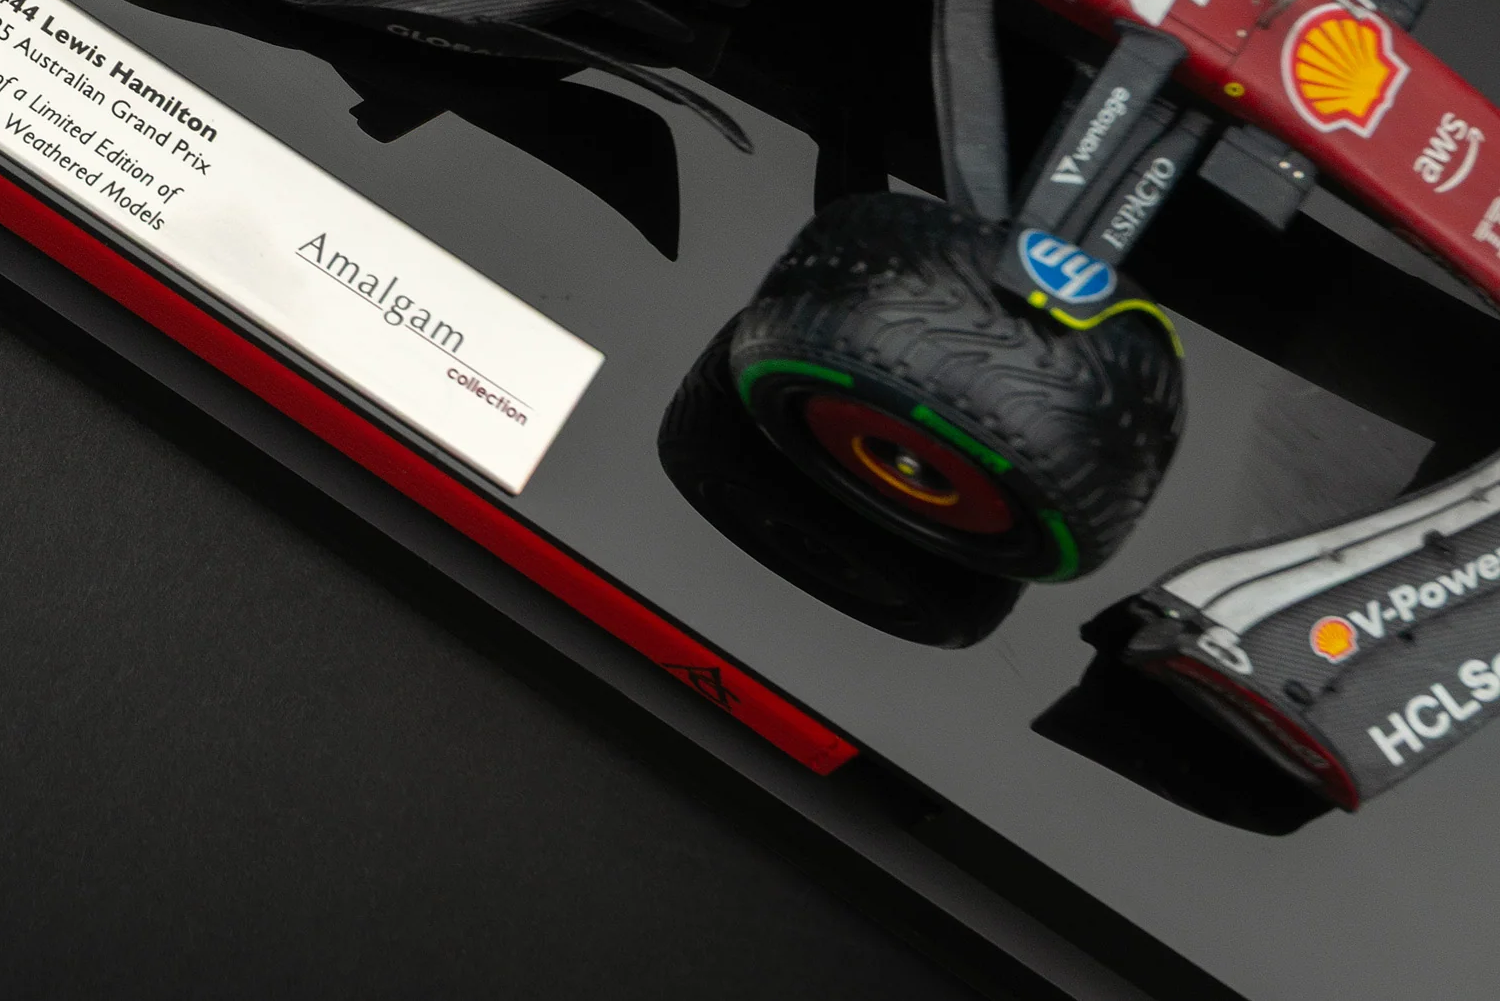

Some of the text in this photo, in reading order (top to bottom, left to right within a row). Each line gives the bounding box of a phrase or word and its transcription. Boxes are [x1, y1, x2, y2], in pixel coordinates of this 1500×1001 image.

[13, 37, 107, 106] Australian
[110, 99, 173, 148] Grand
[171, 138, 212, 176] Prix
[40, 15, 107, 68] Lewis
[109, 61, 219, 142] Hamilton
[4, 112, 104, 187] Weathered
[99, 180, 166, 232] Models
[13, 87, 28, 101] a
[28, 93, 98, 146] Limited
[94, 137, 156, 188] Edition
[156, 183, 186, 205] of
[1412, 111, 1468, 185] aws
[297, 231, 466, 353] Amalgam
[1024, 233, 1110, 301] hp
[446, 366, 529, 426] collection
[1346, 547, 1500, 640] V-Powe
[1366, 651, 1500, 767] HCLS
